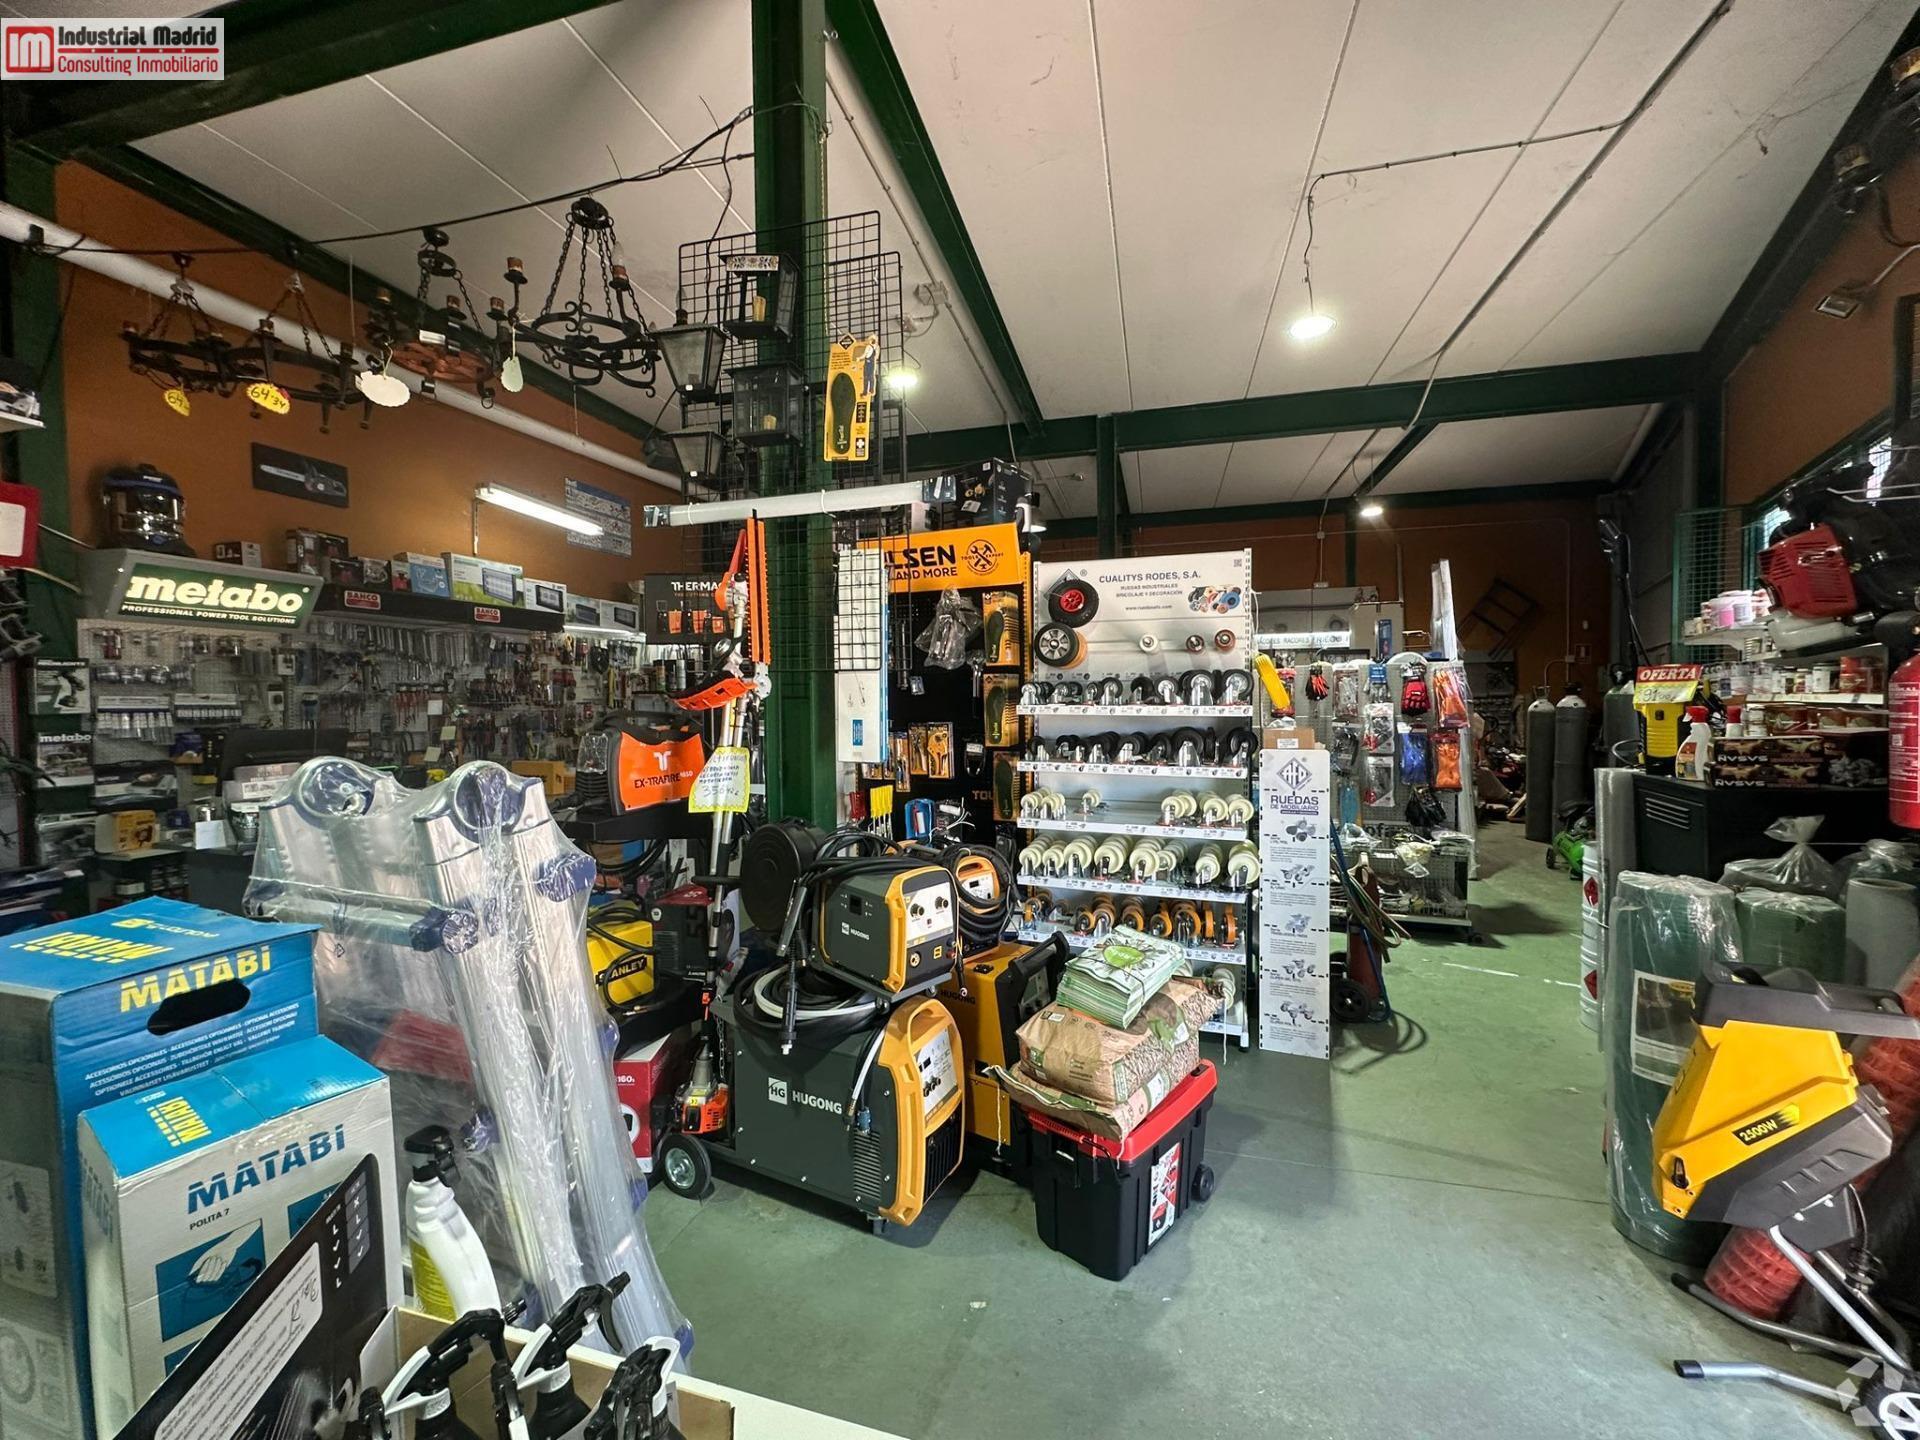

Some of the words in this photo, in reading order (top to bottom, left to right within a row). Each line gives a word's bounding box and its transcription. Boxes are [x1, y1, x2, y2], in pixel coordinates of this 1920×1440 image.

[923, 566, 958, 579] MORE
[1099, 573, 1144, 584] CUALITYS
[1183, 570, 1201, 580] S.A.
[125, 576, 303, 613] metabo
[121, 604, 194, 616] PROFESSIONAL
[196, 611, 228, 620] POWER
[251, 616, 296, 624] SOLUTIONS
[1639, 667, 1696, 681] OFERTA
[39, 733, 92, 744] metabo
[634, 772, 682, 789] EX-TRAFIRE
[1270, 794, 1319, 806] RUEDAS
[121, 945, 271, 1013] MATABI
[771, 1087, 786, 1098] HG
[792, 1090, 843, 1115] HUGONG
[1739, 1119, 1778, 1142] 2500W
[188, 1124, 346, 1215] MATABI
[189, 1211, 222, 1231] POLITA
[223, 1207, 230, 1217] 7
